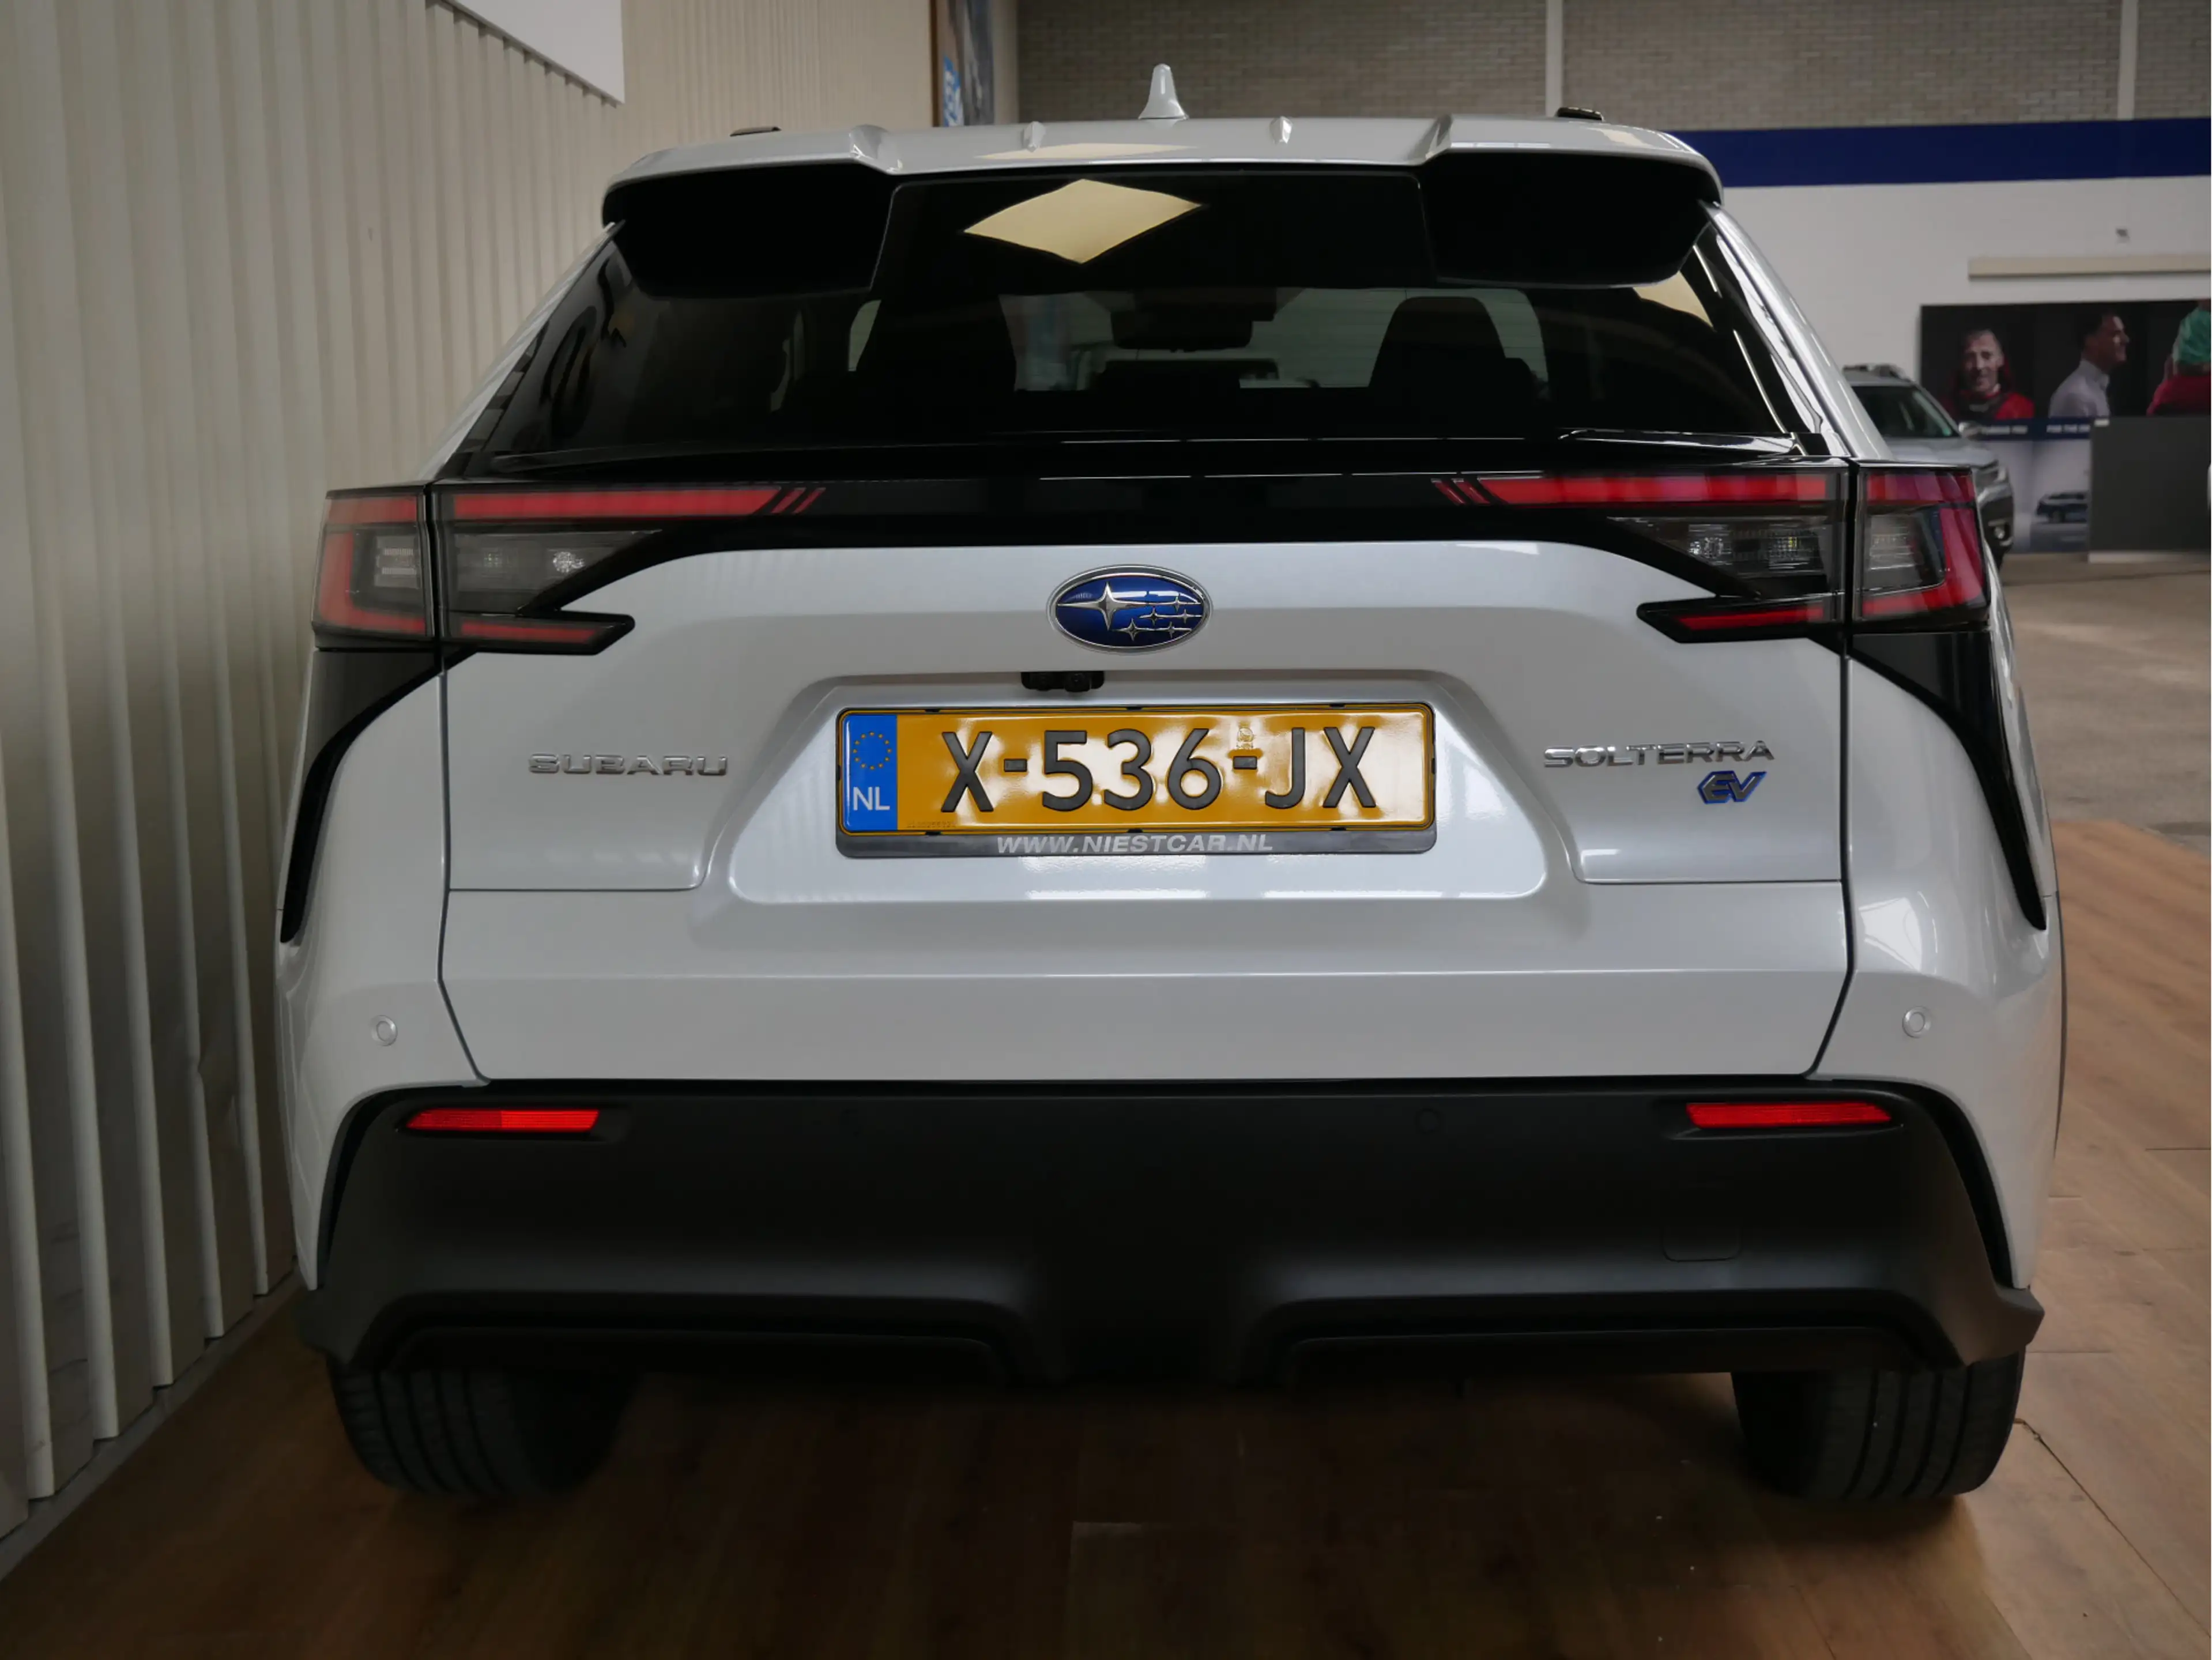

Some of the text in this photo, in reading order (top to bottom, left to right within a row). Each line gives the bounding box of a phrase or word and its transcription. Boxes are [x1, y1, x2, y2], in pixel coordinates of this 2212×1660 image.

[529, 753, 728, 776] SUBARU
[1543, 740, 1775, 768] SOLTERRA
[940, 726, 1377, 813] X-536-JX
[852, 786, 891, 811] NL
[1697, 770, 1768, 804] EV
[997, 833, 1273, 854] WWW.NIESTCAR.NL
